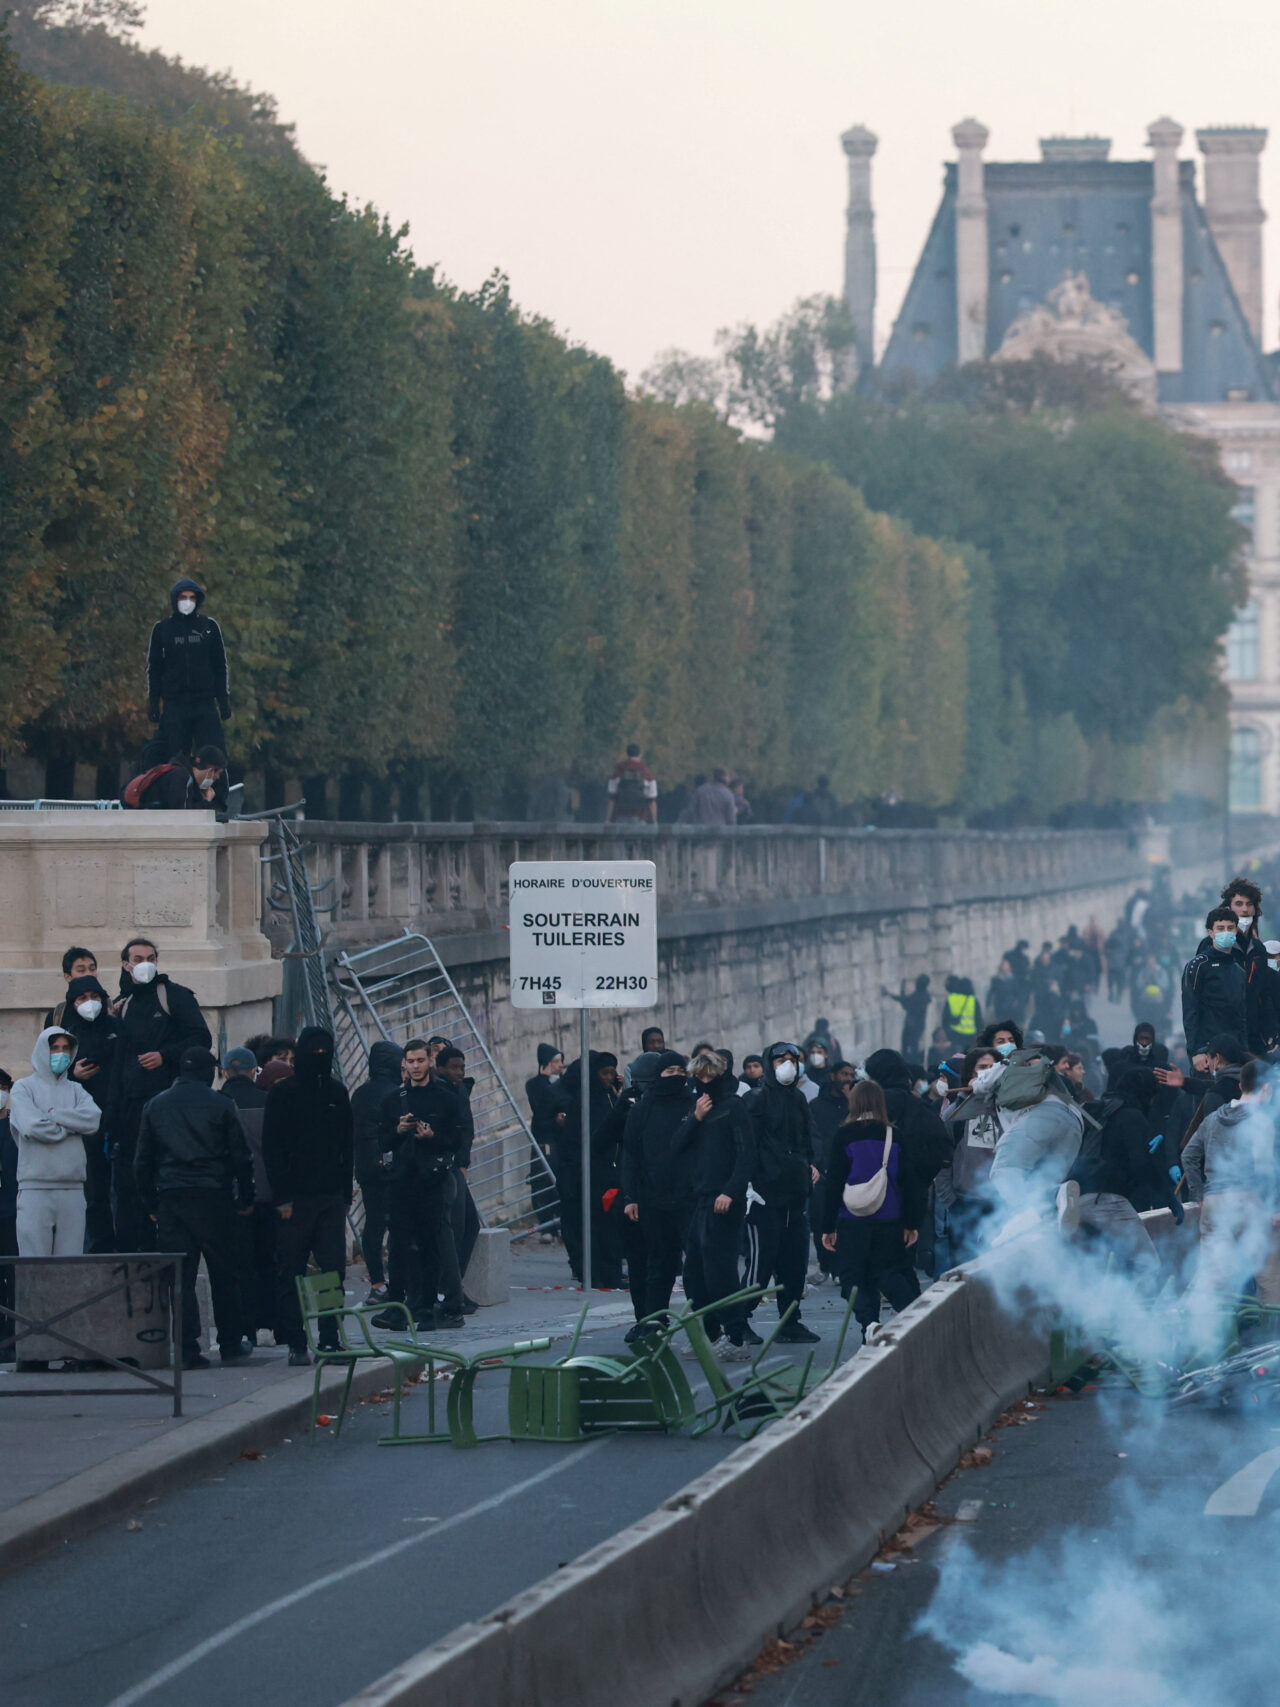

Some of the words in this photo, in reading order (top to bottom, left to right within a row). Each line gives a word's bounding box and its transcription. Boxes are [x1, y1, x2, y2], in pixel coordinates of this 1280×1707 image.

[514, 878, 565, 889] HORAIRE
[572, 878, 653, 889] D'OUVERTURE
[523, 912, 640, 928] SOUTERRAIN
[532, 931, 625, 946] TUILERIES
[520, 976, 562, 990] 7H45
[595, 976, 648, 990] 22H30
